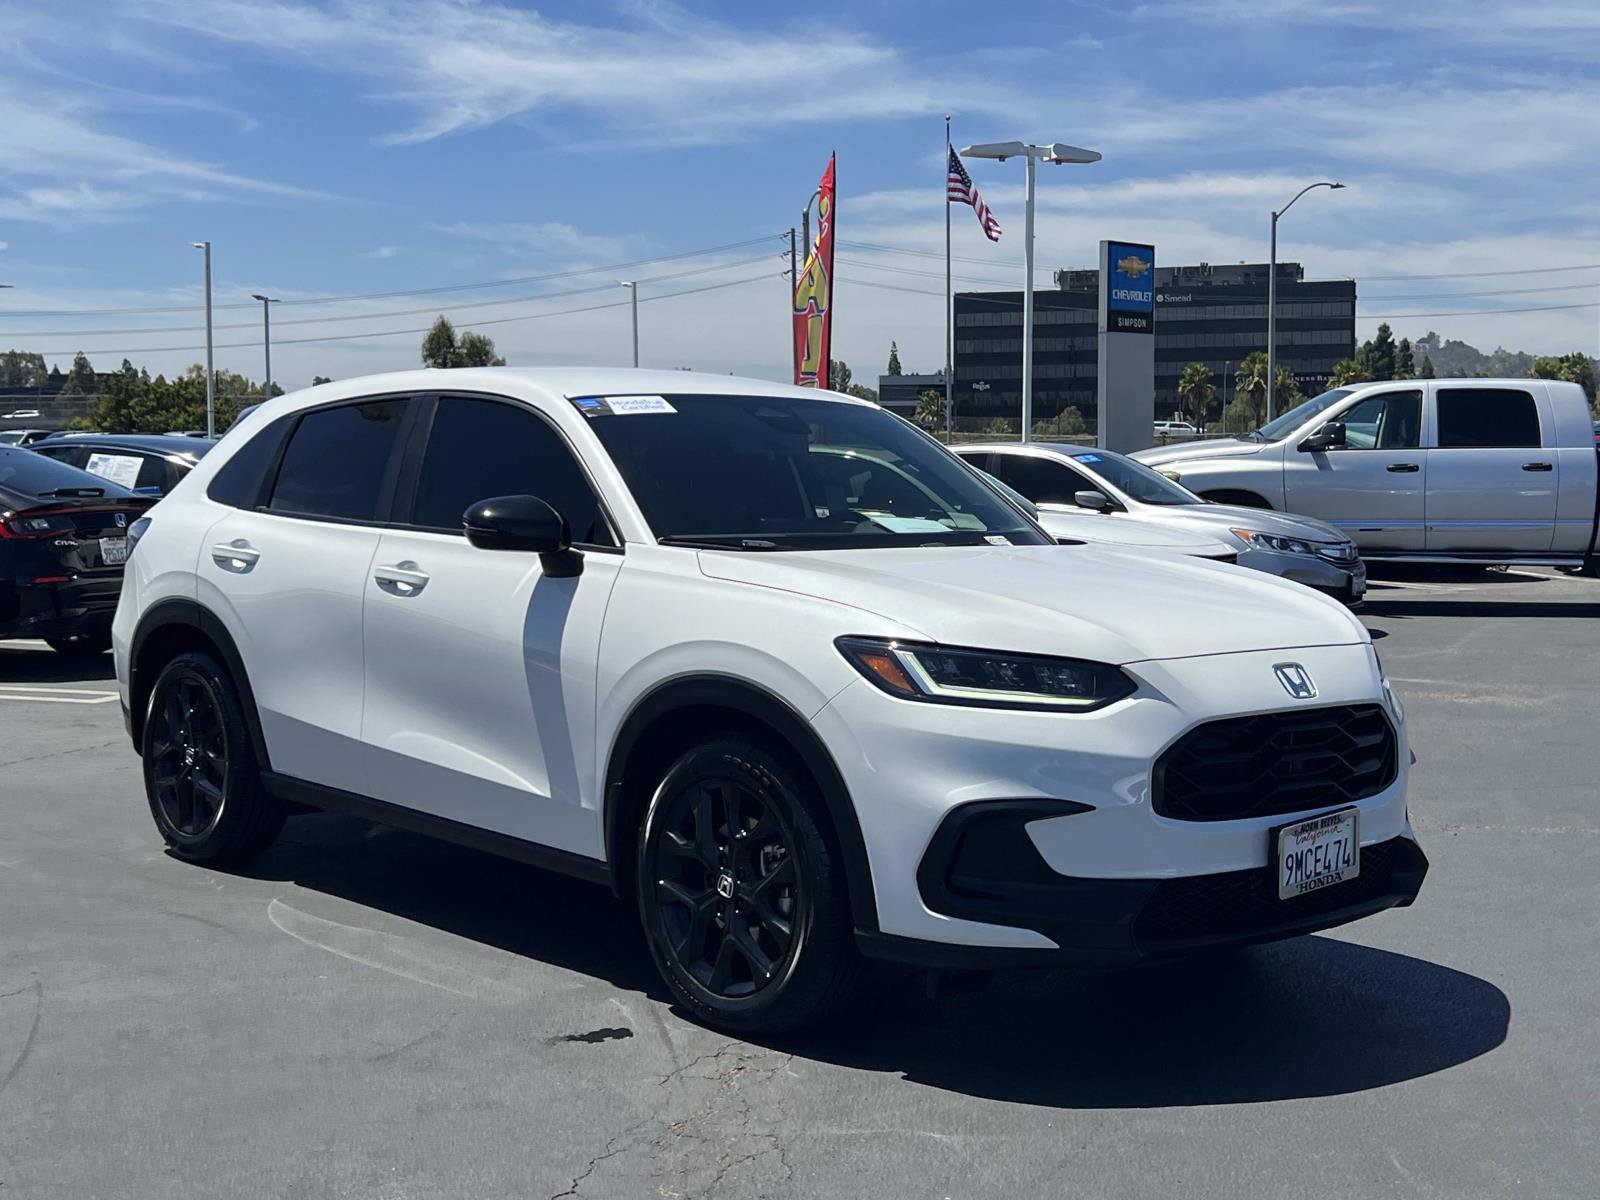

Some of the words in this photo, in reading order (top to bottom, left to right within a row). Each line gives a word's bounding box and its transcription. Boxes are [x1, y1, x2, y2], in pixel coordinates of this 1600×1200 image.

[1112, 289, 1153, 302] CHEVROLET
[1164, 293, 1192, 303] Smead
[1118, 317, 1147, 328] SIMPSON
[1285, 838, 1351, 887] 9MCE474
